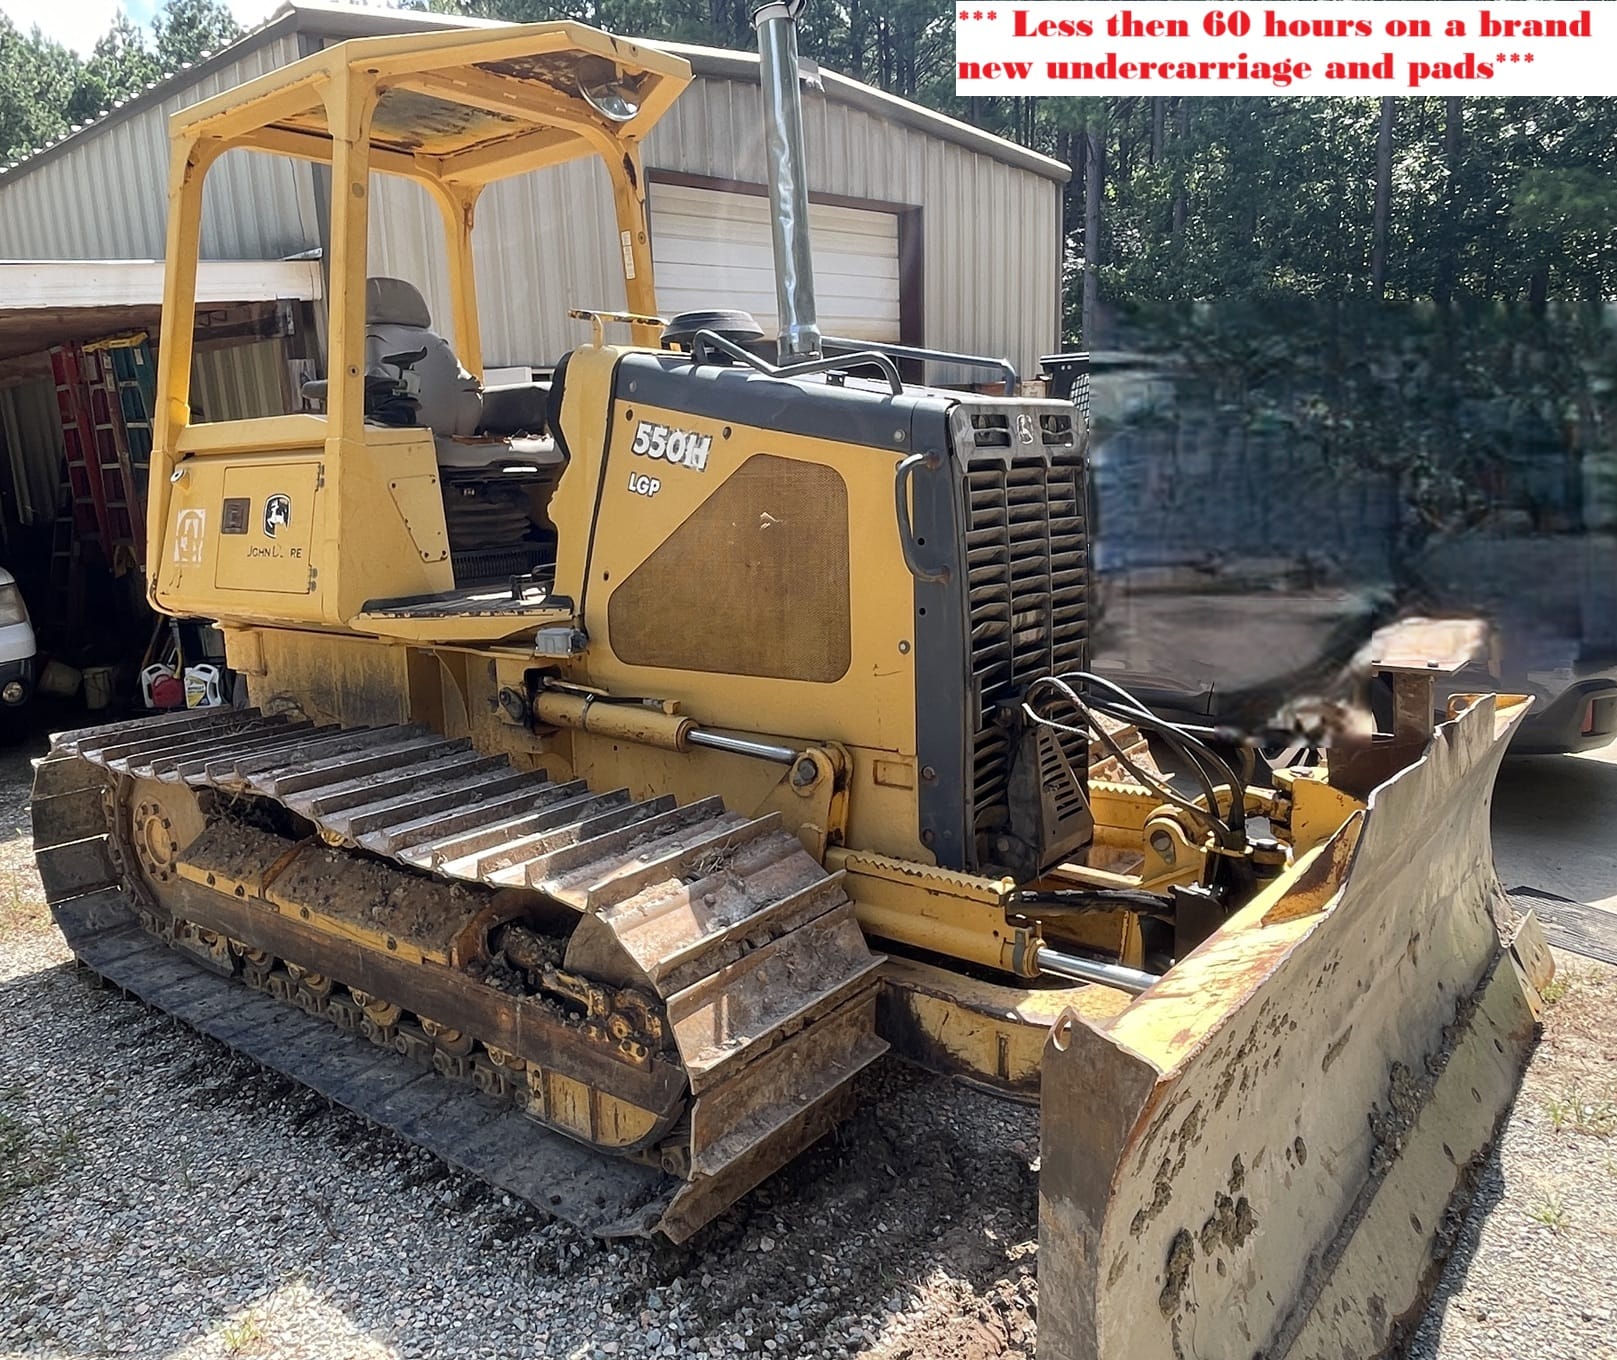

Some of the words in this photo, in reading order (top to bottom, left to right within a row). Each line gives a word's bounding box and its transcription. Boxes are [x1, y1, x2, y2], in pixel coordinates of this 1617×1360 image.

[632, 421, 712, 471] 550H
[628, 472, 661, 497] LGP
[247, 545, 271, 558] JOHN
